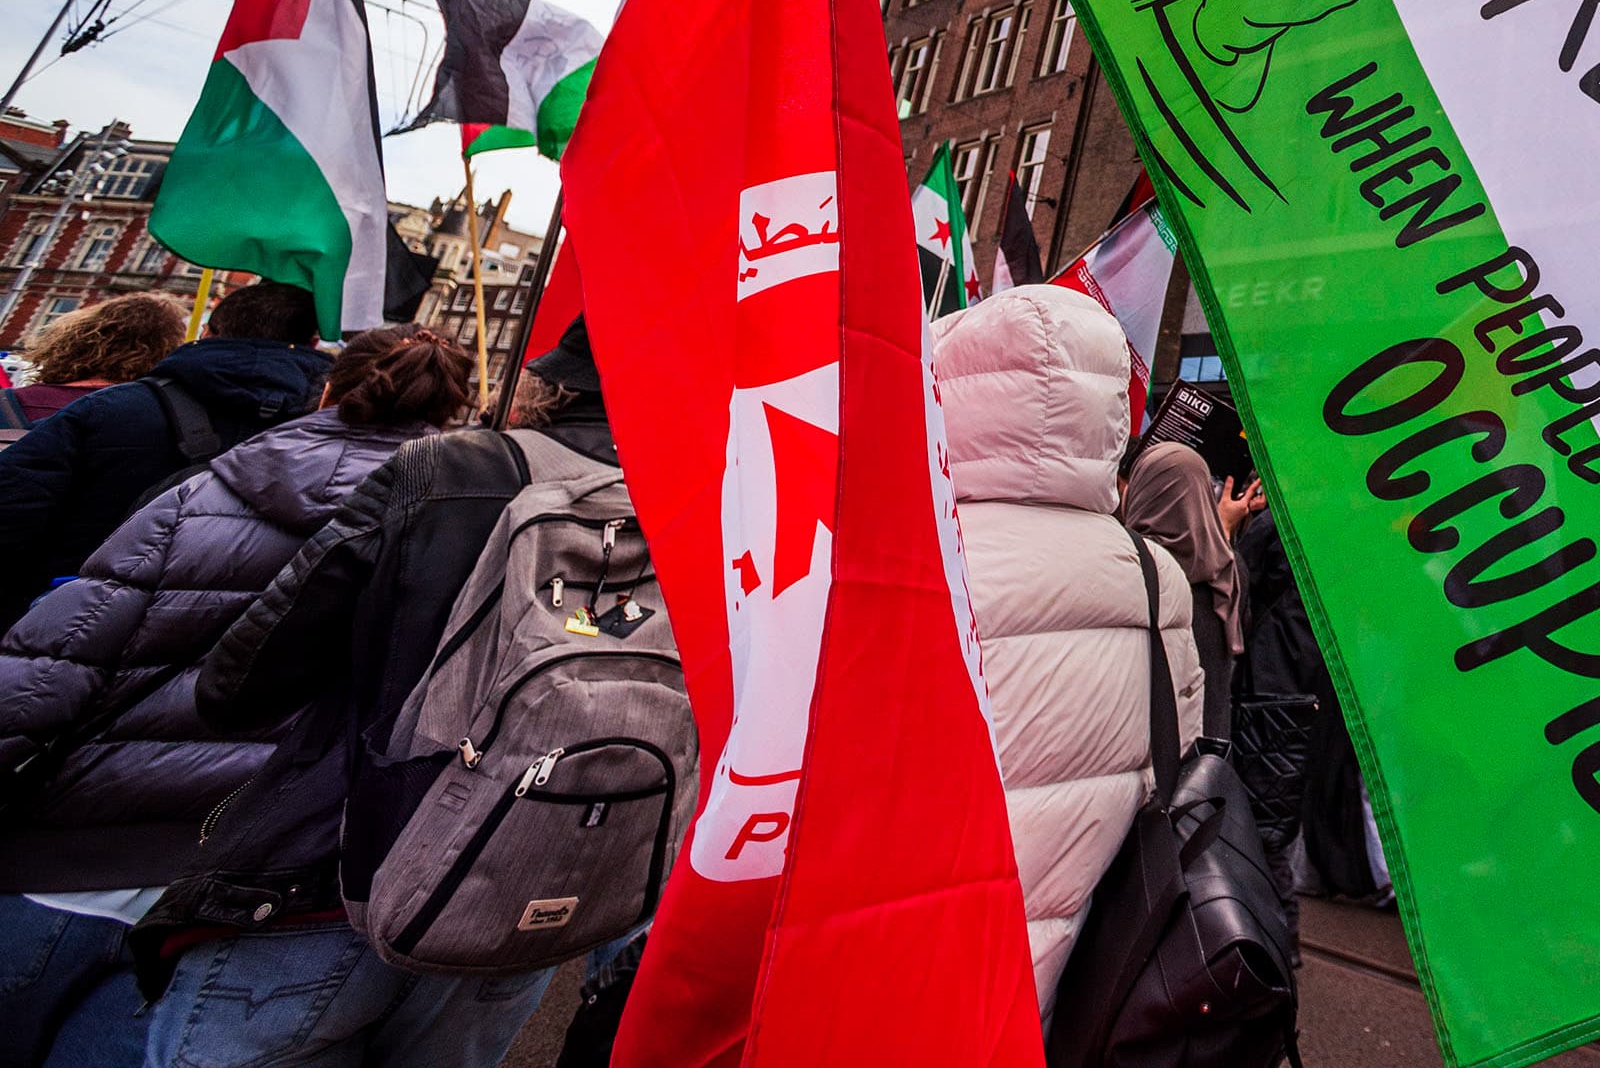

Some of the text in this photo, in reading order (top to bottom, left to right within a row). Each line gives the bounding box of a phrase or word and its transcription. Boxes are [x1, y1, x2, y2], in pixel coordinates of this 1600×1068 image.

[1305, 61, 1487, 249] WHEN
[1214, 275, 1326, 308] EEKR
[1178, 389, 1211, 414] BIKO
